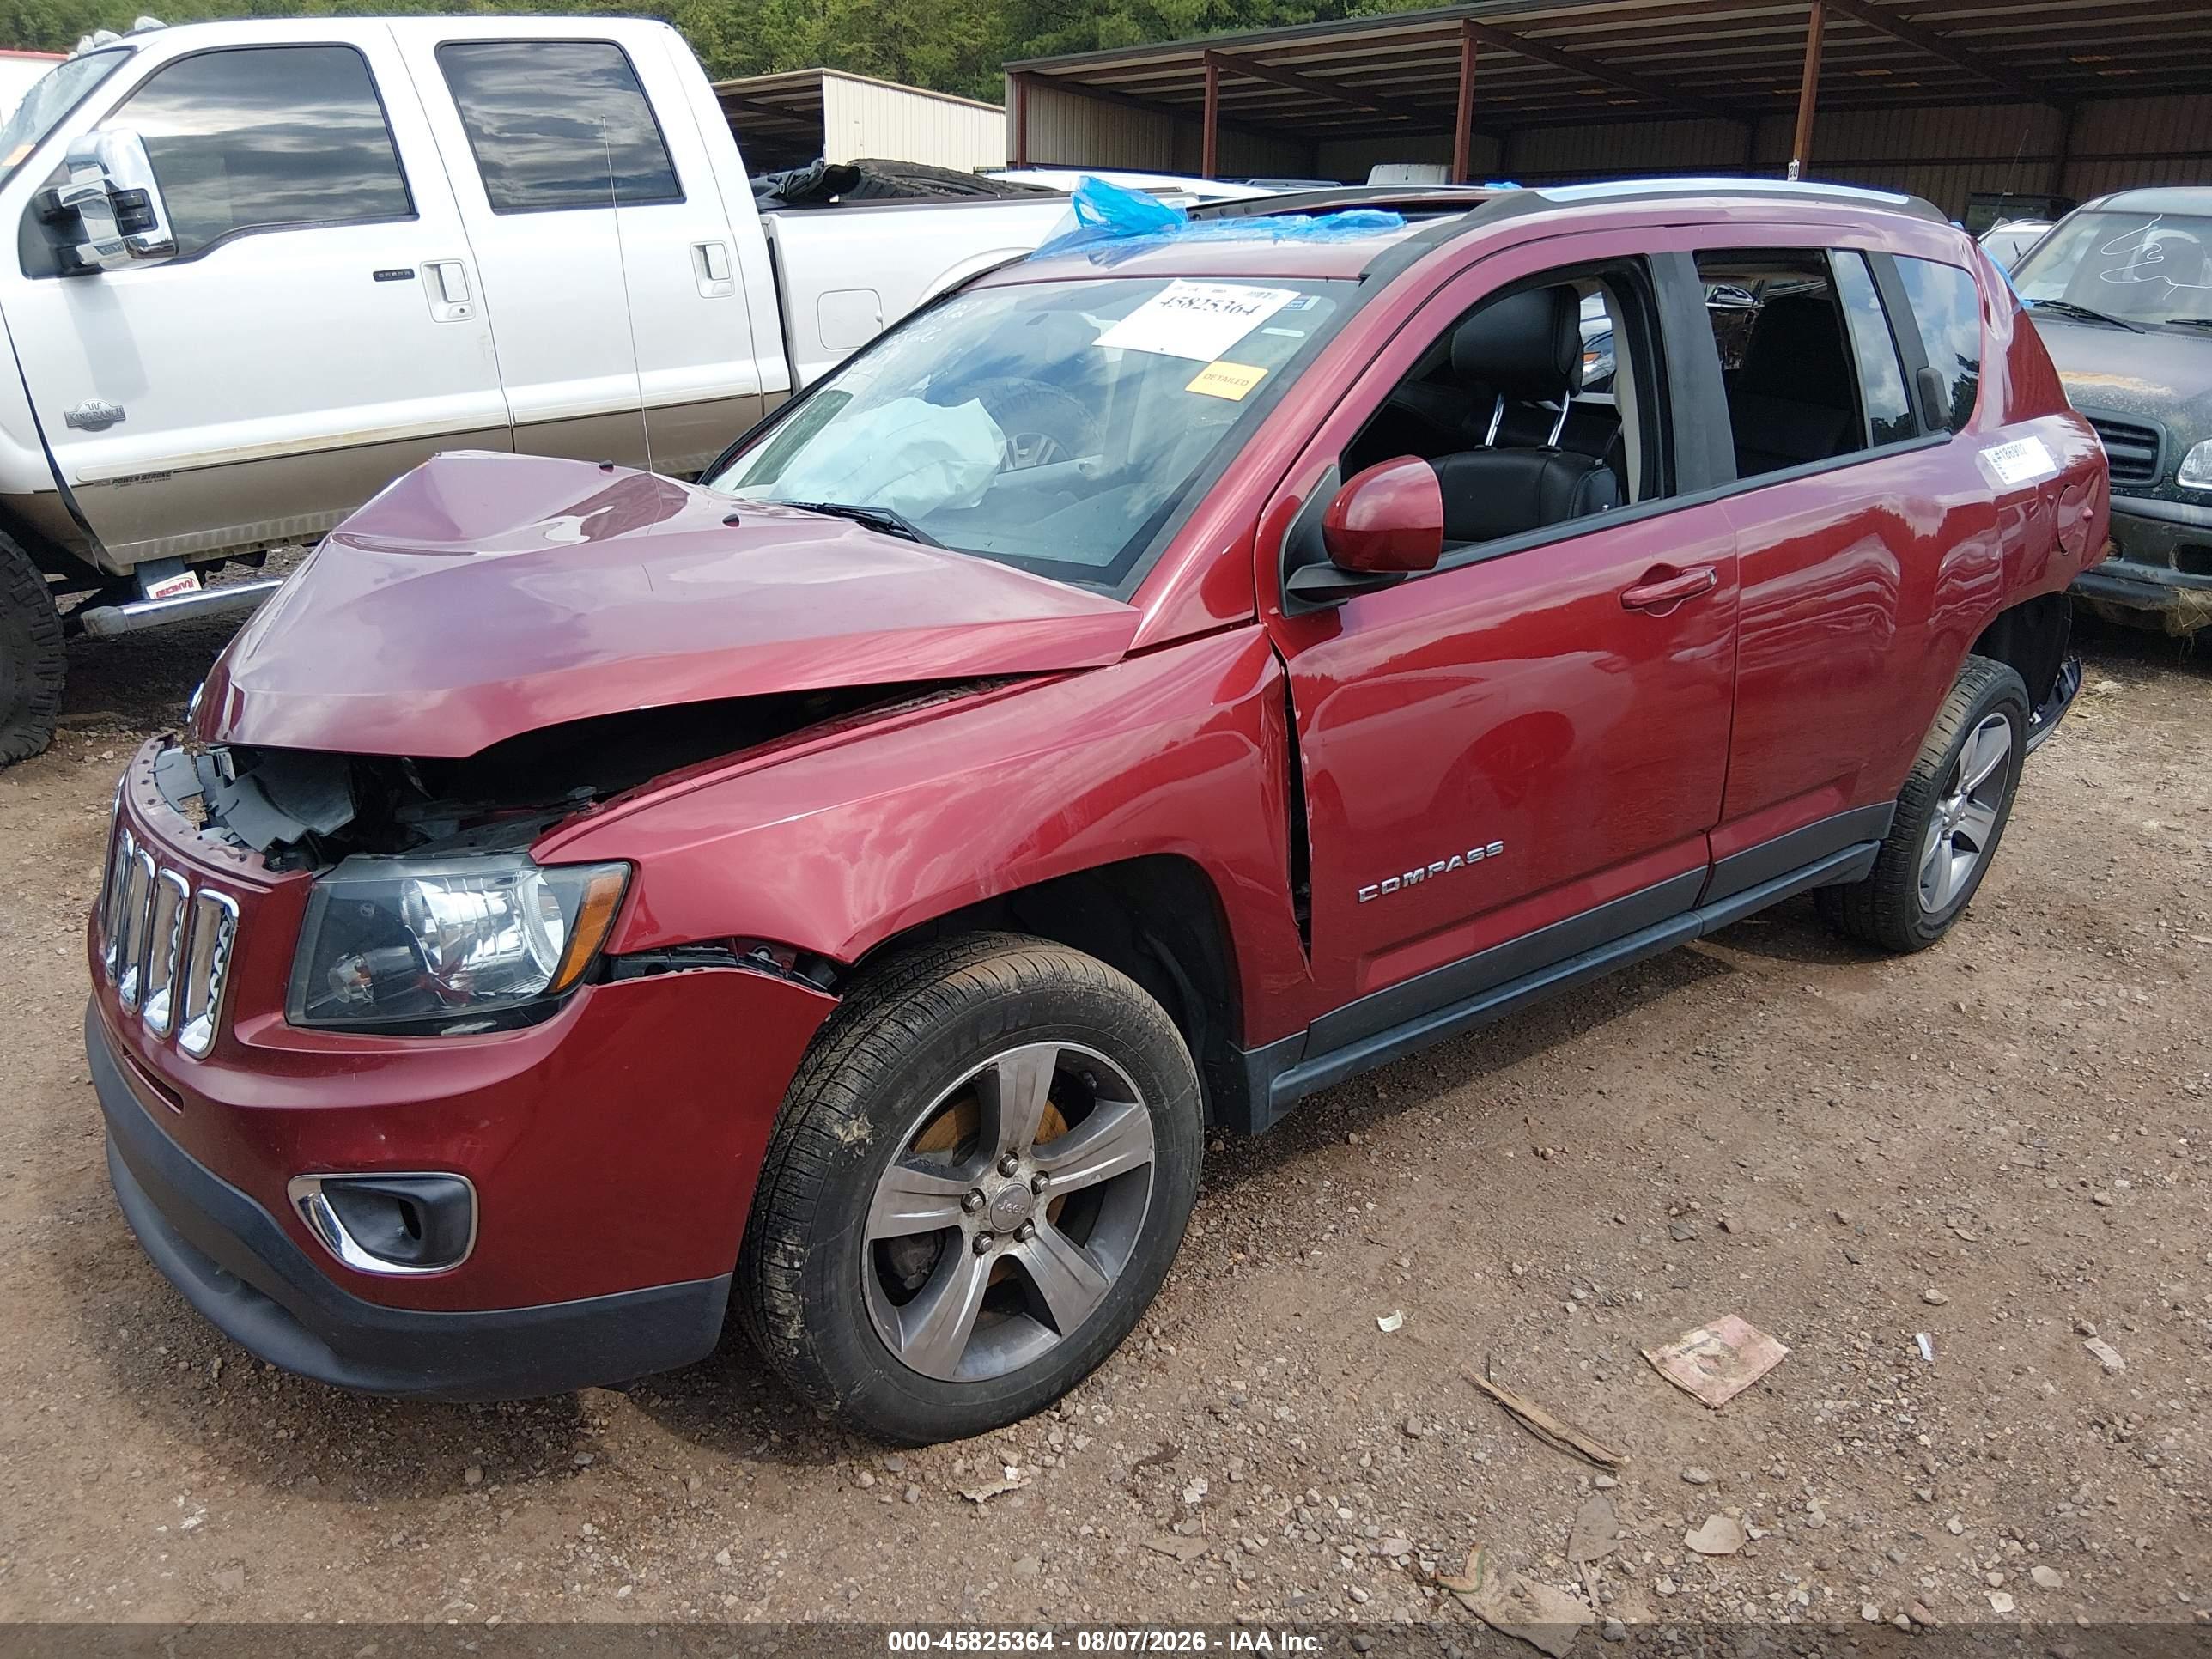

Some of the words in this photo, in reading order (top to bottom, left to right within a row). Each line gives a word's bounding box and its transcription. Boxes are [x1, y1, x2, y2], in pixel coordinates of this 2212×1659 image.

[1790, 165, 1798, 178] 20
[1160, 296, 1262, 316] 45825364
[1203, 374, 1249, 386] DETAILED
[1358, 840, 1504, 903] COMPASS
[997, 1200, 1024, 1214] Jeep
